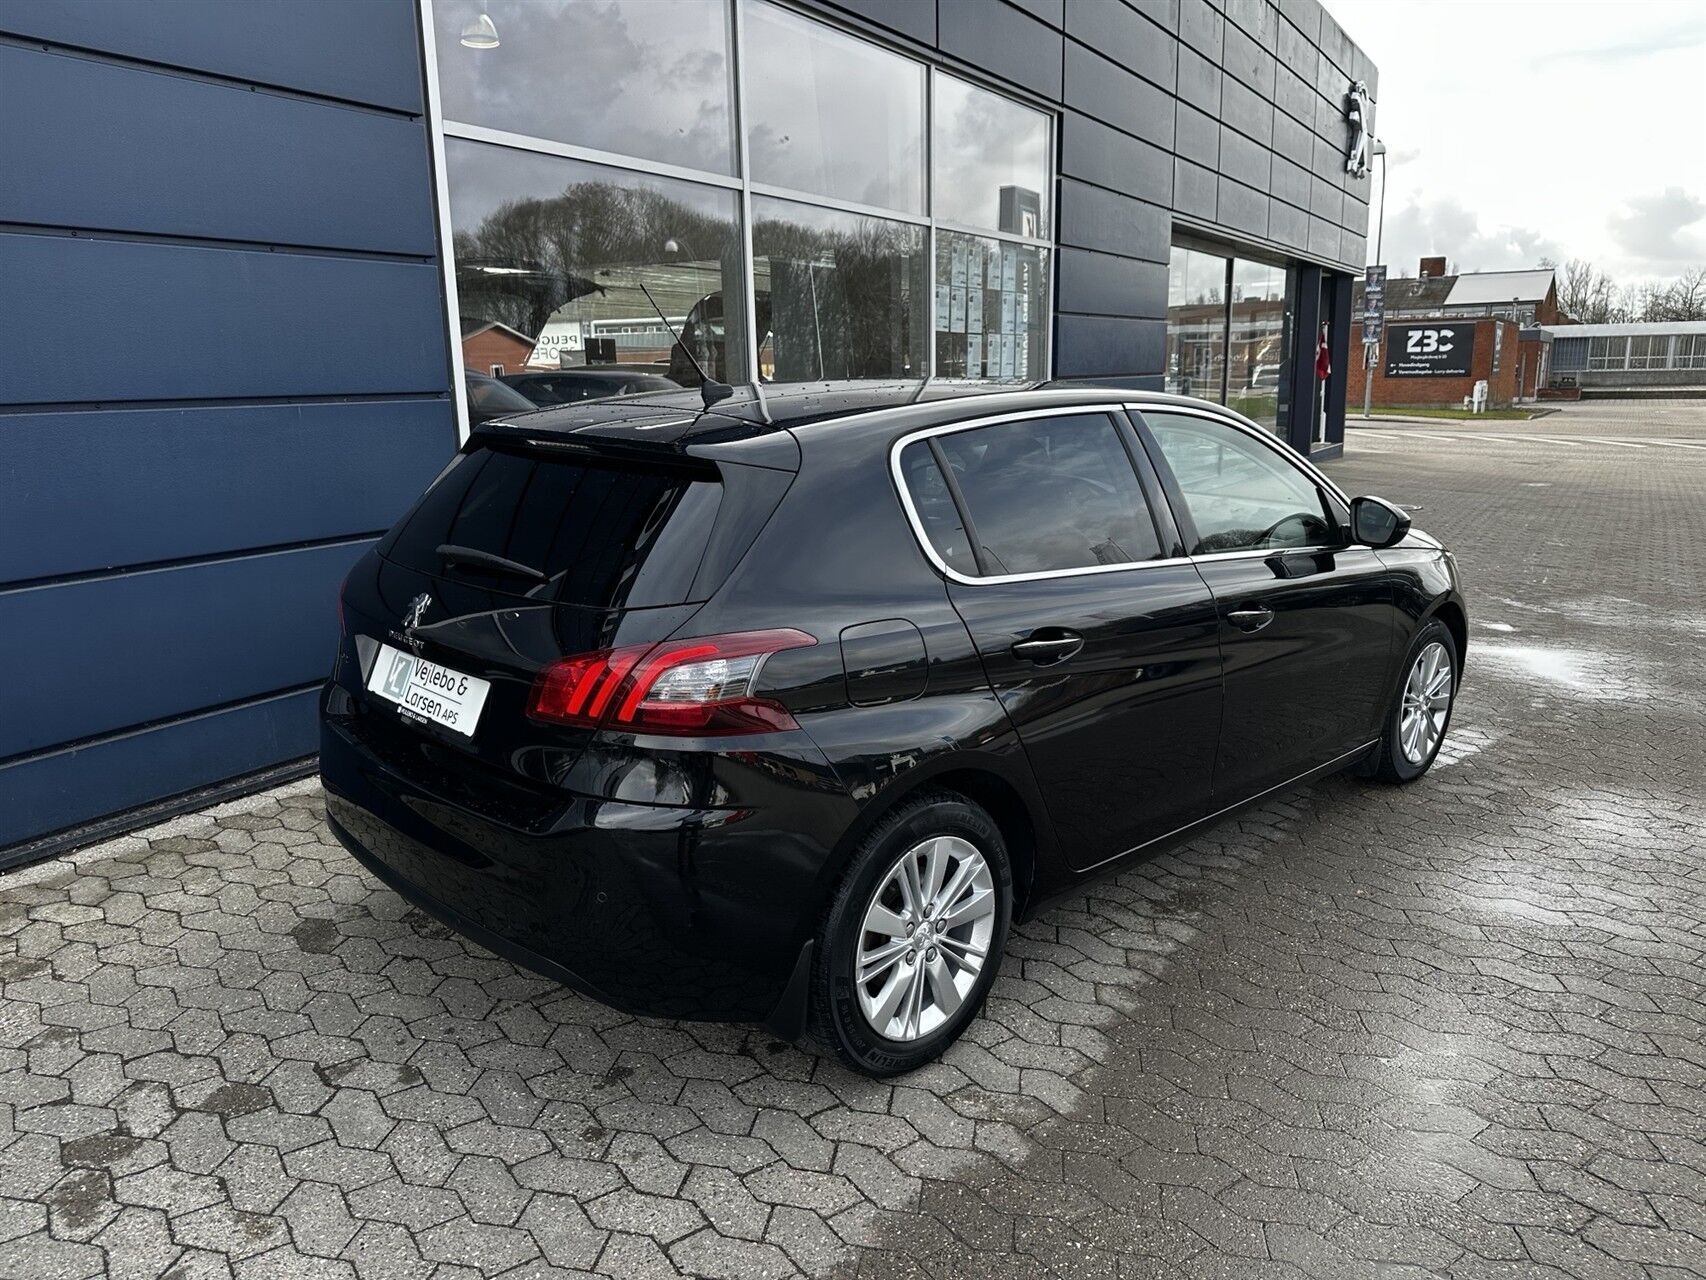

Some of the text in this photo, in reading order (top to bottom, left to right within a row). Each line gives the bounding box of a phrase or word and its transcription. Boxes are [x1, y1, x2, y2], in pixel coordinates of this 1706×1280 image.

[415, 659, 468, 696] Vejlebo &
[405, 685, 442, 717] Larsen
[441, 708, 459, 725] APS
